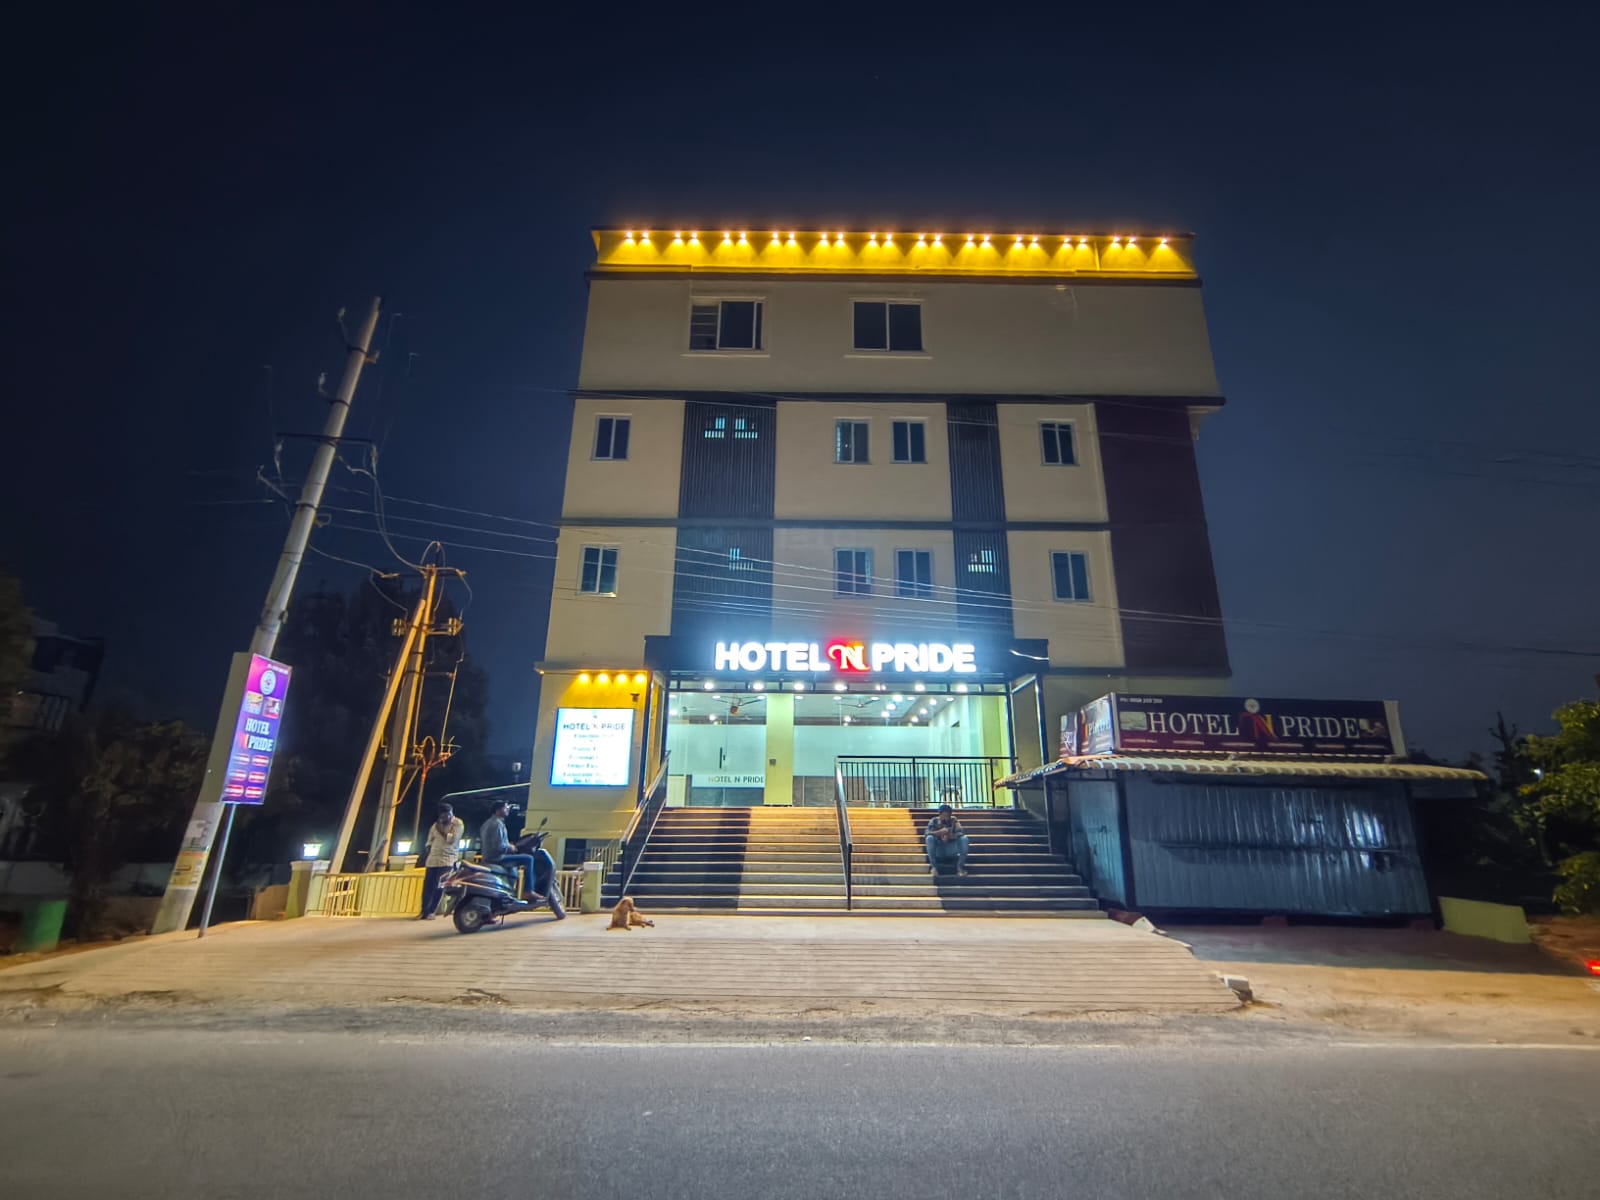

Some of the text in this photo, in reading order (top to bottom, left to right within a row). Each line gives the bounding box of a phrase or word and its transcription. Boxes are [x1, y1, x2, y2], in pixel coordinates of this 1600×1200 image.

[714, 642, 830, 672] HOTEL
[871, 643, 977, 673] PRIDE
[244, 717, 270, 735] HOTEL
[563, 723, 590, 731] HOTEL
[1149, 711, 1240, 736] HOTEL
[1279, 715, 1361, 739] PRIDE
[248, 735, 274, 752] PRIDE
[708, 775, 765, 784] HOTEL N PRIDE
